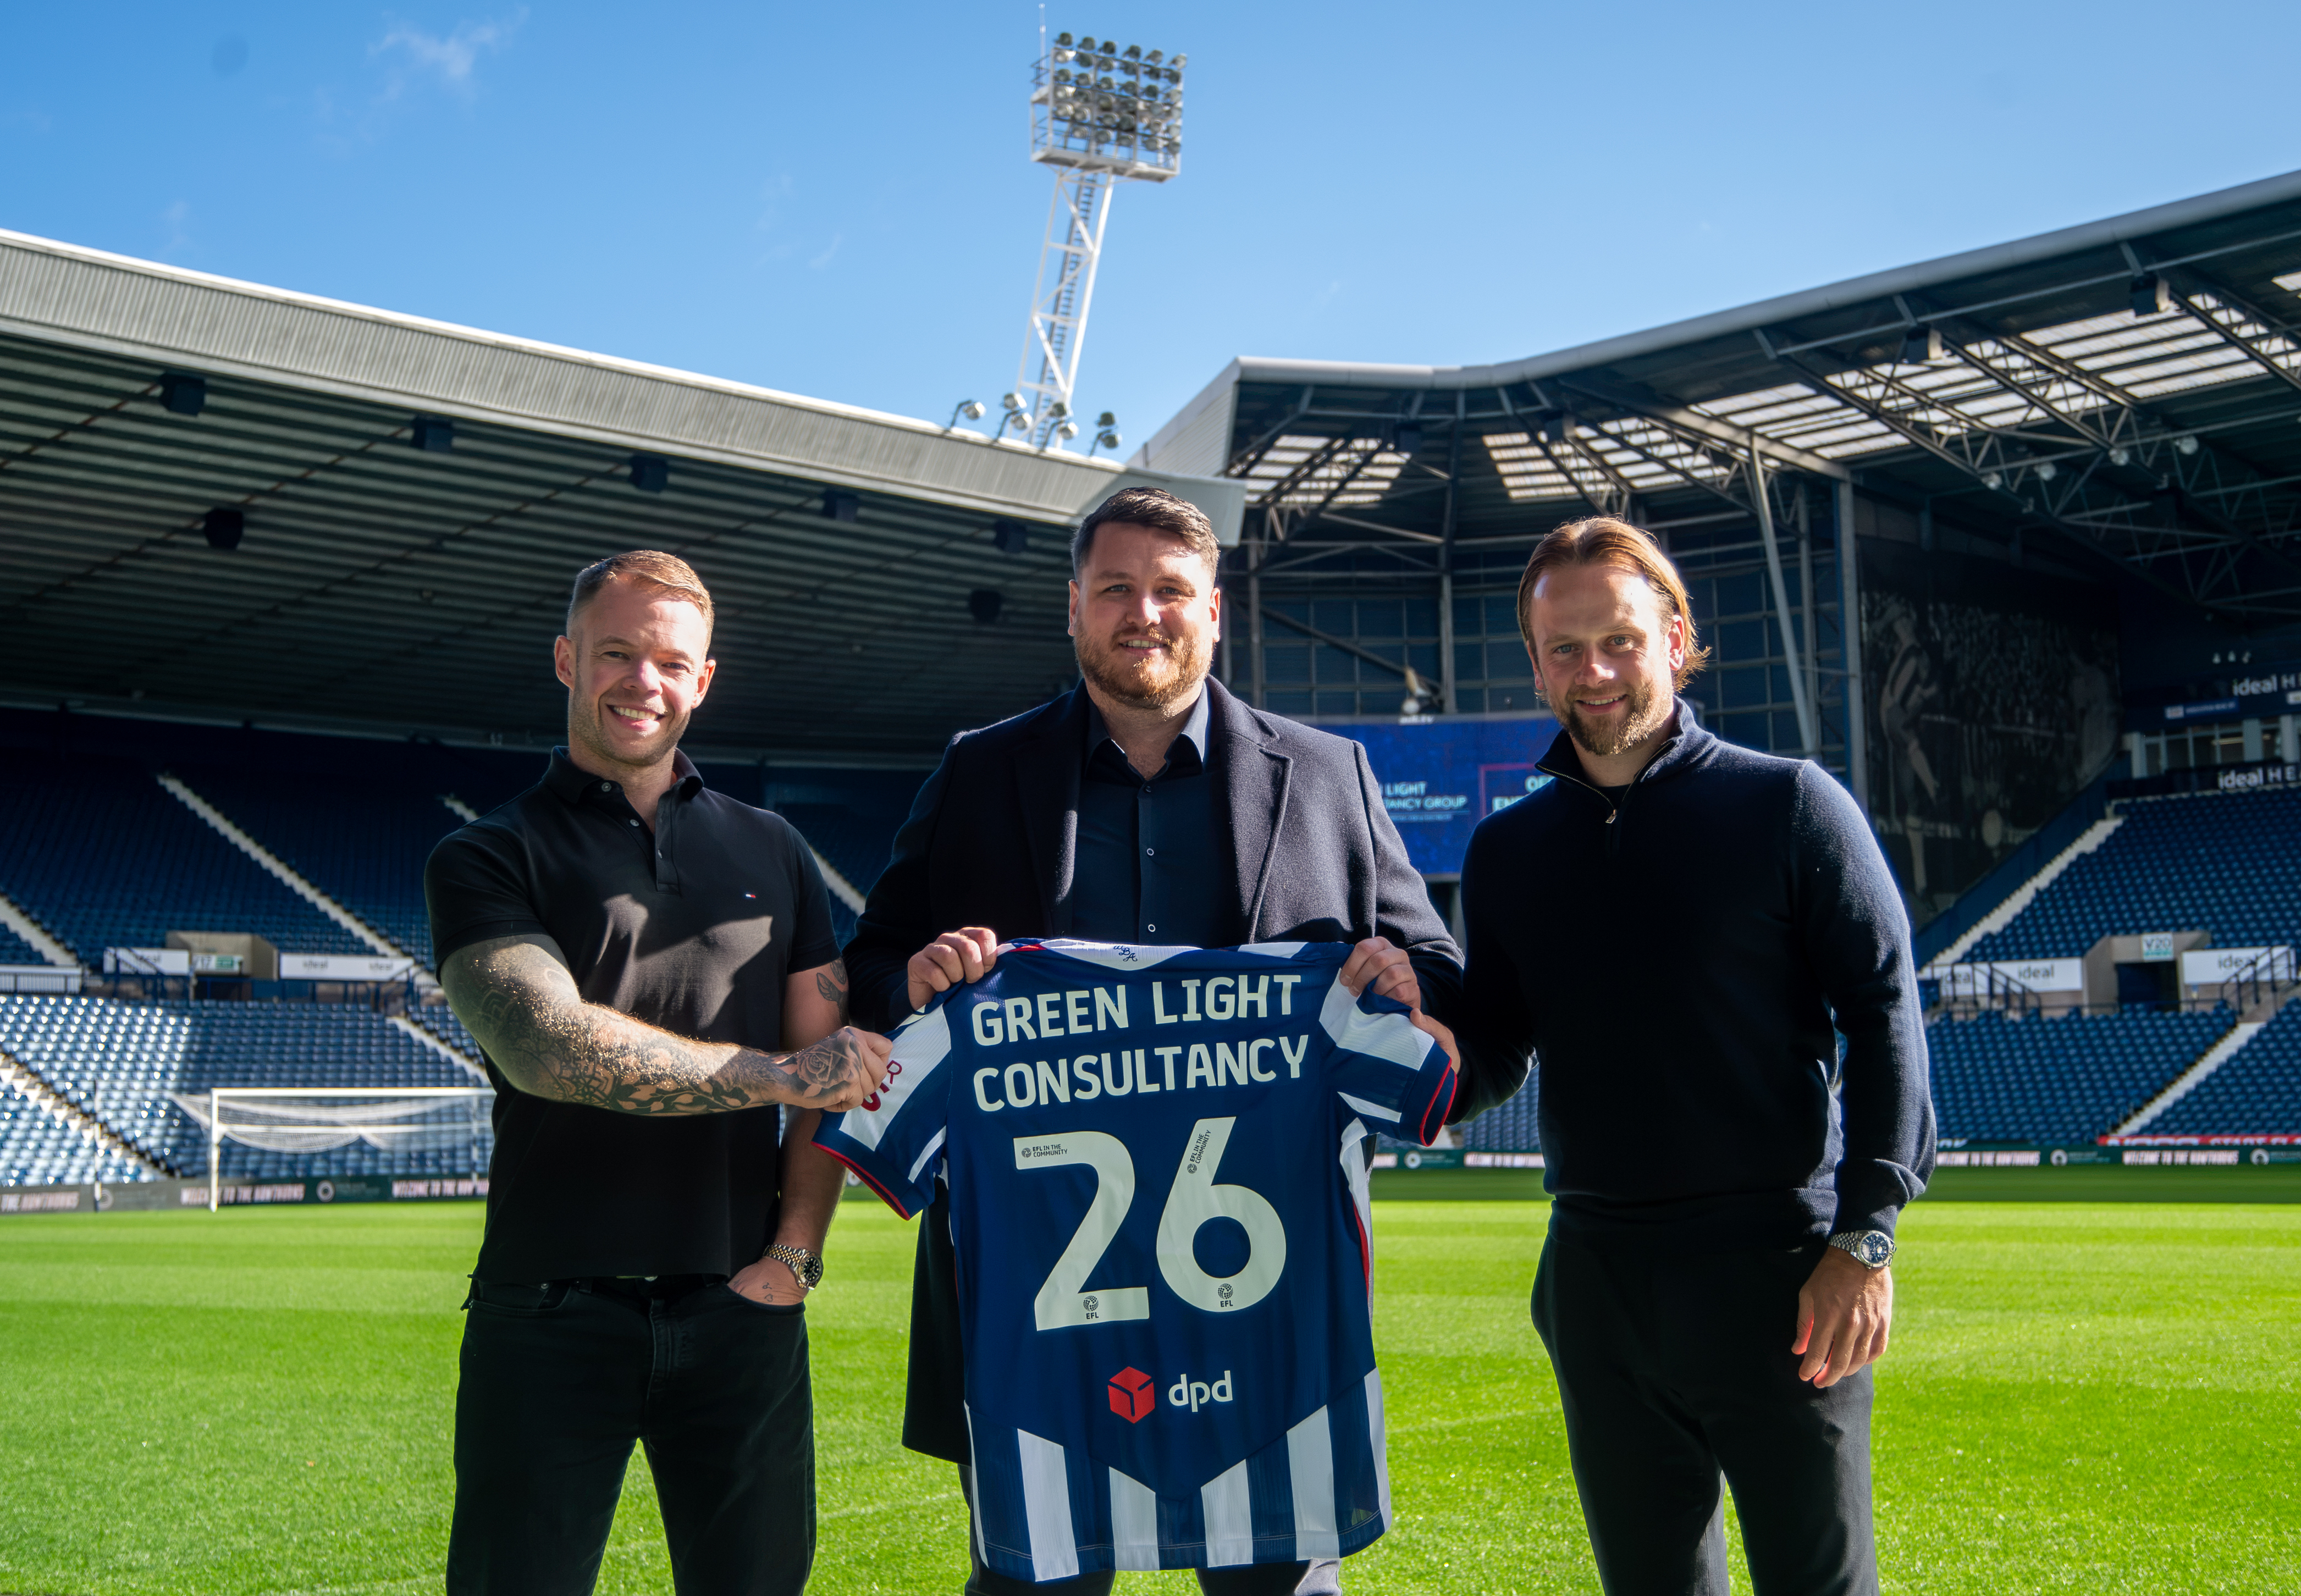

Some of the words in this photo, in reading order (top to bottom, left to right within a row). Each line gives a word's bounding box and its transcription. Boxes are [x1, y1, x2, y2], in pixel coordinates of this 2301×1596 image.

[2232, 673, 2277, 696] ideal
[1386, 781, 1427, 796] LIGHT
[2218, 767, 2264, 789] ideal
[1422, 796, 1467, 810] GROUP
[2018, 964, 2054, 979] ideal
[2218, 953, 2256, 970] ide
[972, 985, 1129, 1046] GREEN
[1152, 975, 1301, 1025] LIGHT
[973, 1034, 1309, 1112] CONSULTANCY
[1033, 1148, 1067, 1157] COMMUNITY
[1189, 1152, 1198, 1162] EFL
[1196, 1133, 1204, 1144] THE
[1195, 1130, 1211, 1164] COMMUNITY
[1013, 1116, 1287, 1332] 26
[1169, 1370, 1233, 1412] dpd
